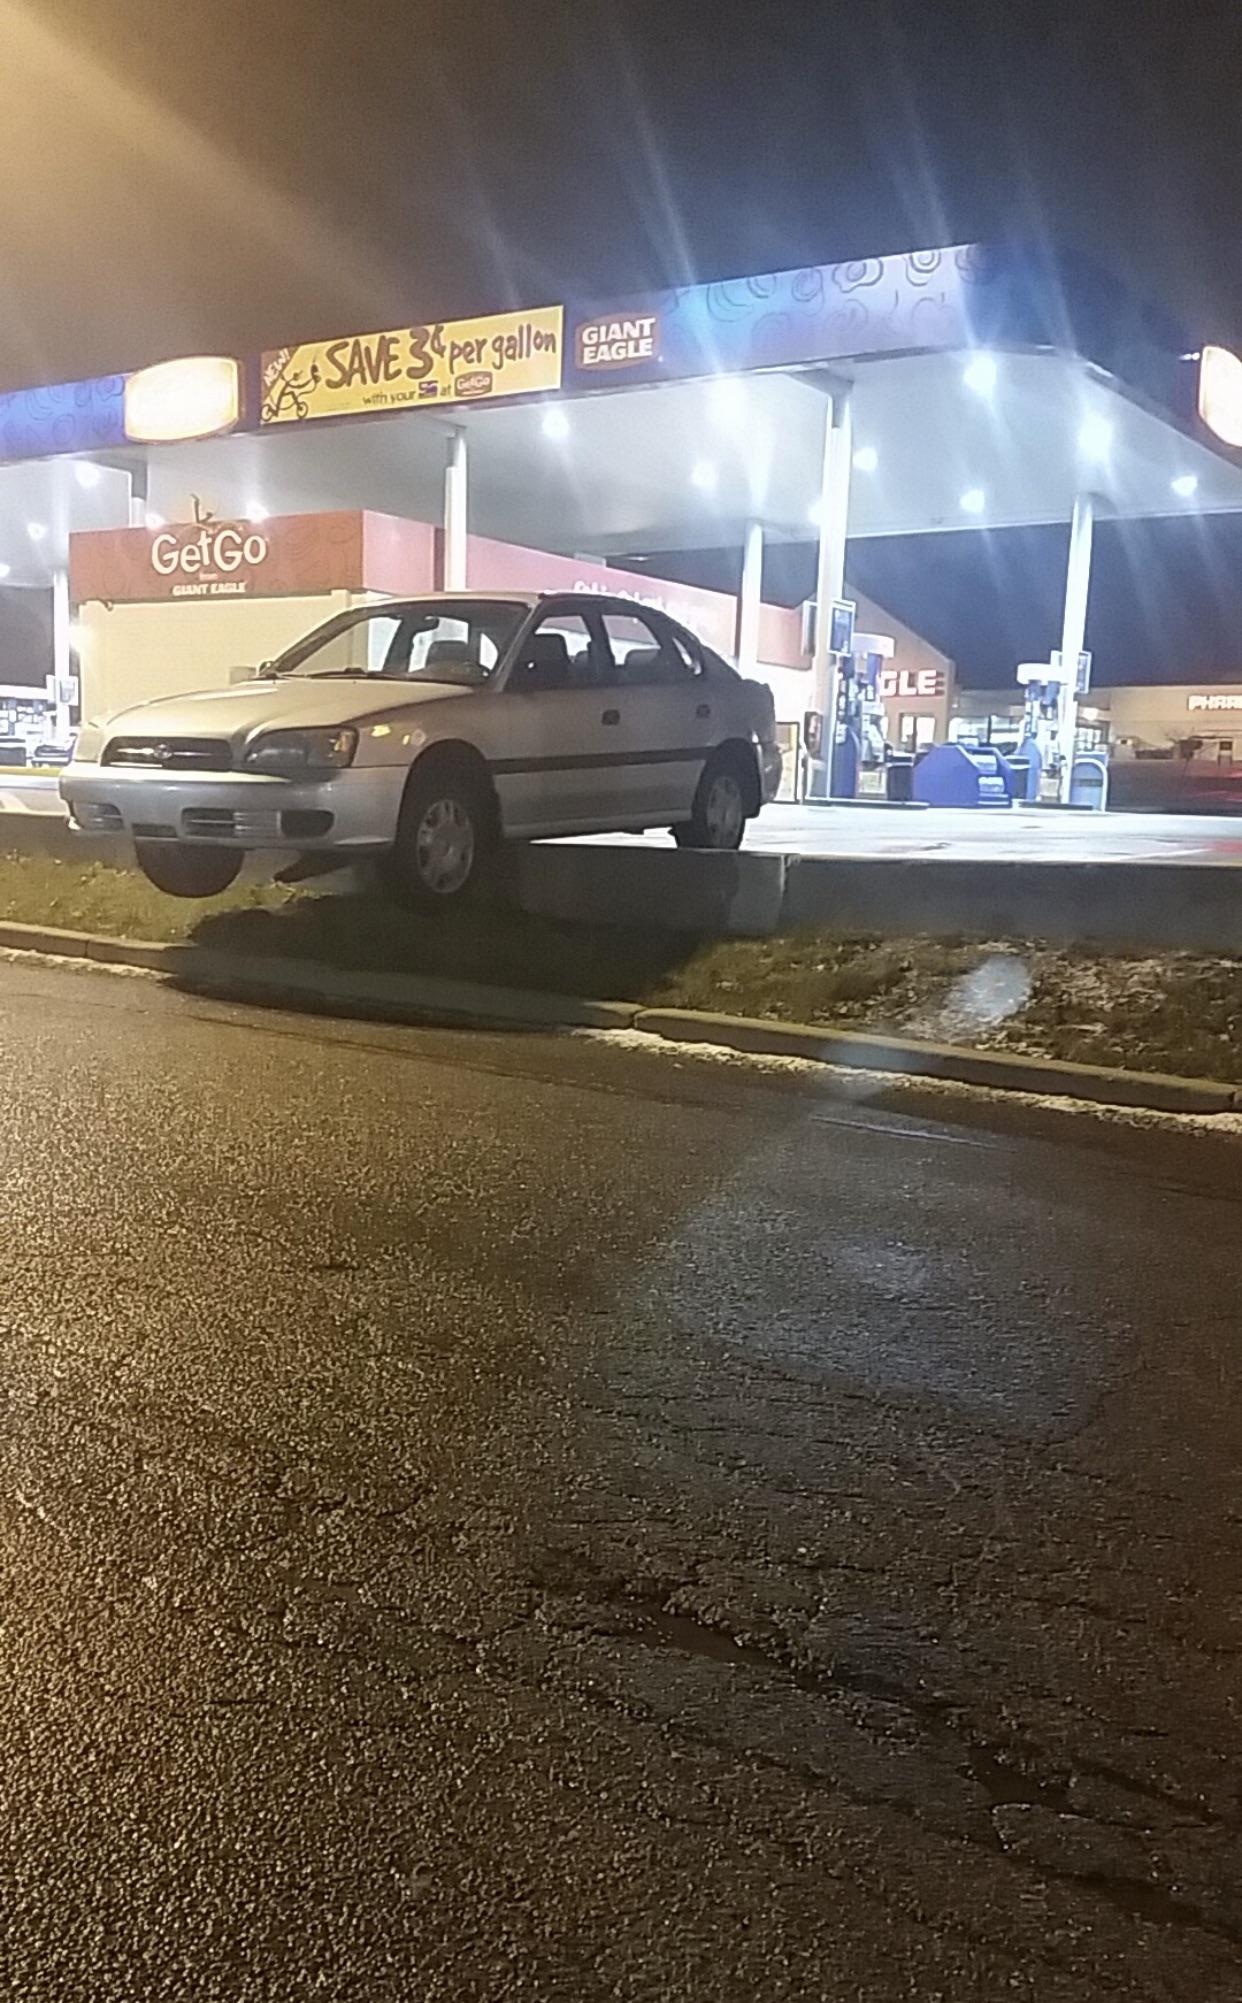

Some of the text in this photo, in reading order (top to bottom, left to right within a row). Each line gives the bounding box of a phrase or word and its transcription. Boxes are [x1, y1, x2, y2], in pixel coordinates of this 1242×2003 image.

[582, 317, 656, 345] GIANT
[325, 336, 402, 389] SAVE
[449, 338, 488, 374] per
[492, 323, 556, 370] gallon
[583, 338, 653, 365] EAGLE
[362, 391, 388, 405] with
[390, 391, 416, 404] your
[440, 384, 451, 397] at
[151, 529, 267, 575] GetGo
[172, 581, 247, 596] GIANT EAGLE
[879, 669, 937, 696] GLE
[1188, 695, 1242, 710] PHAR
